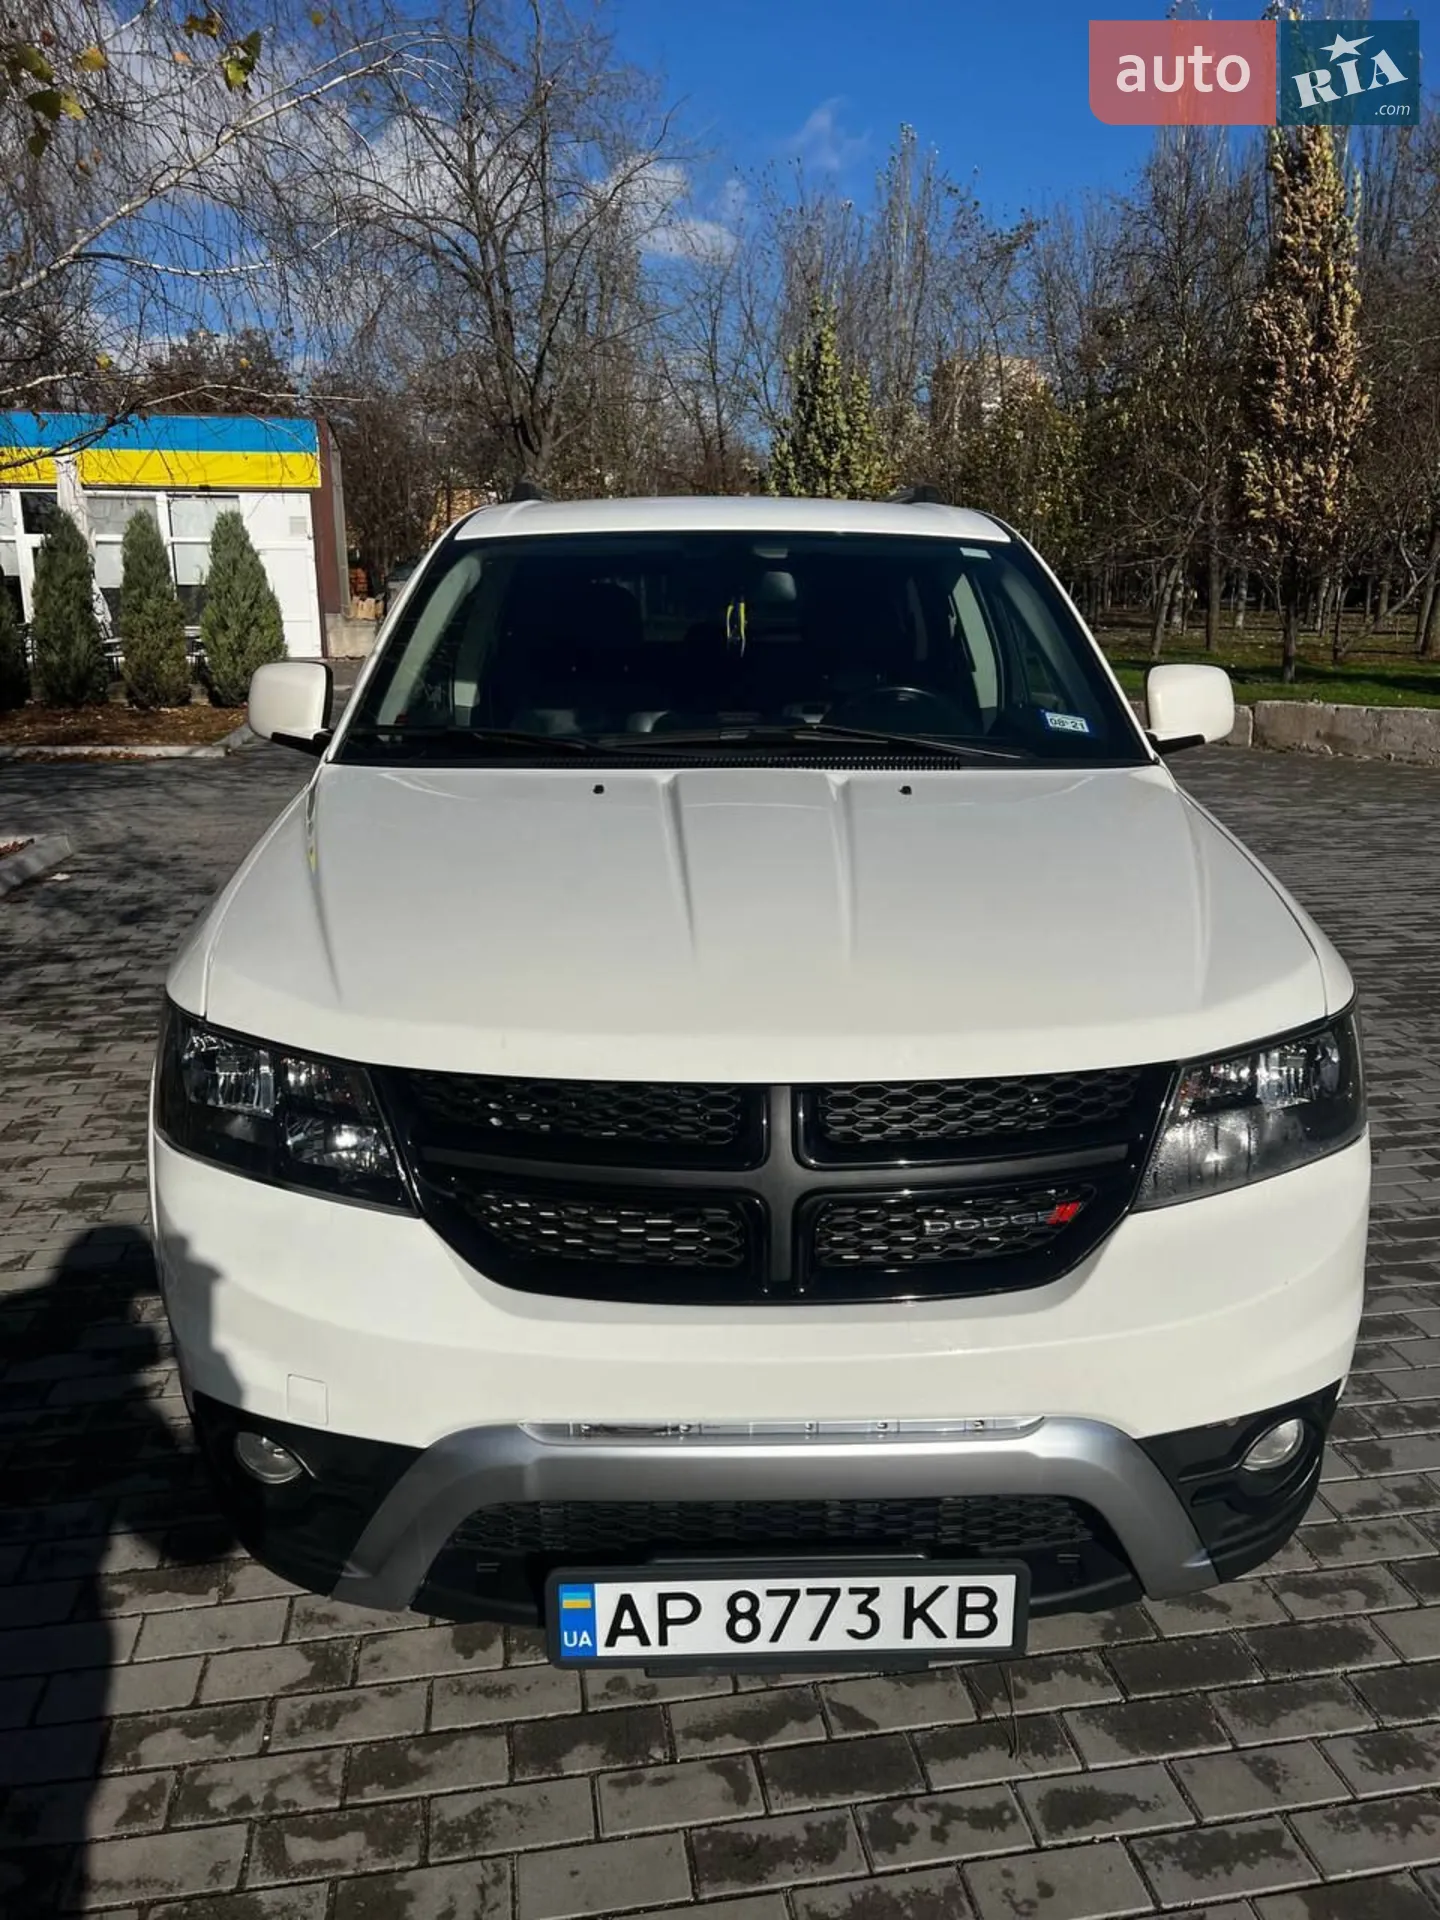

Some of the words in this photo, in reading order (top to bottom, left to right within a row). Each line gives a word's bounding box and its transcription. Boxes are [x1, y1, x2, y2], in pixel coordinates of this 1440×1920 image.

[604, 1592, 702, 1648] AP
[725, 1586, 882, 1644] 8773
[902, 1585, 999, 1641] KB
[563, 1630, 593, 1649] UA
